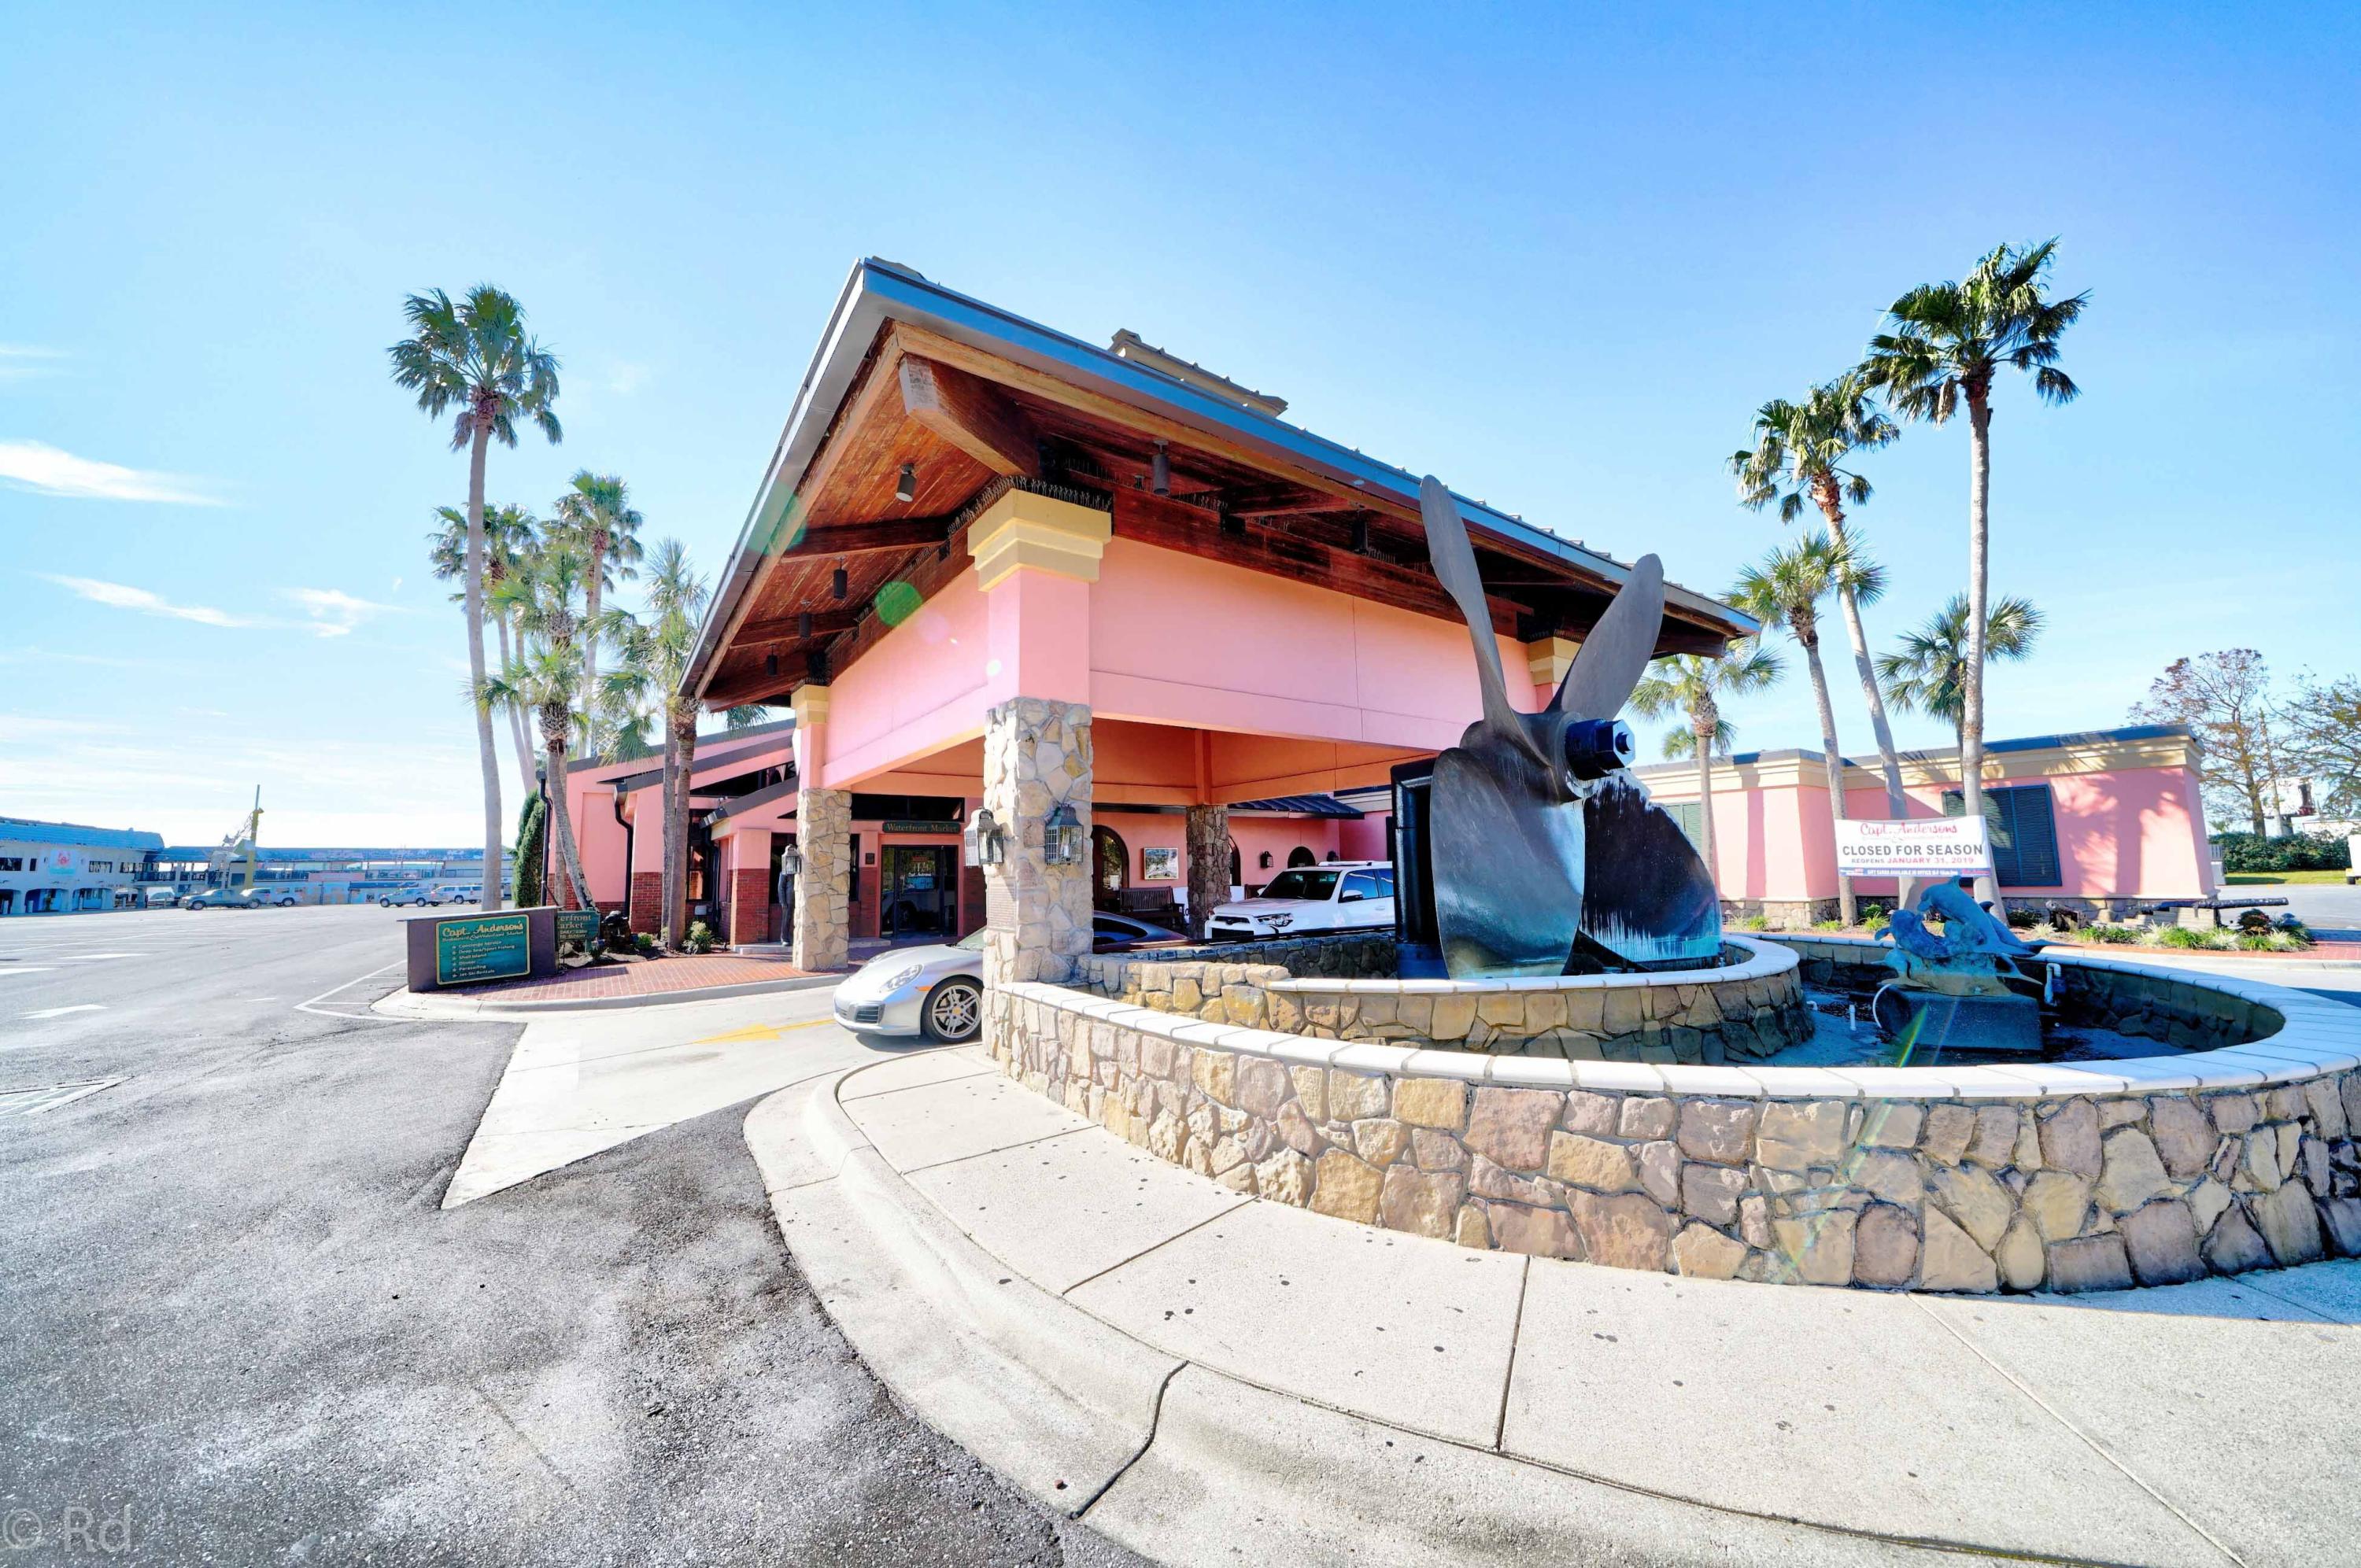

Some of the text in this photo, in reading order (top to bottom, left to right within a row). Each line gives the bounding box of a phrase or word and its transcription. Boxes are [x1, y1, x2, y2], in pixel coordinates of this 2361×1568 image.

[887, 823, 927, 832] Waterfront
[1842, 844, 1982, 855] CLOSED FOR SEASON
